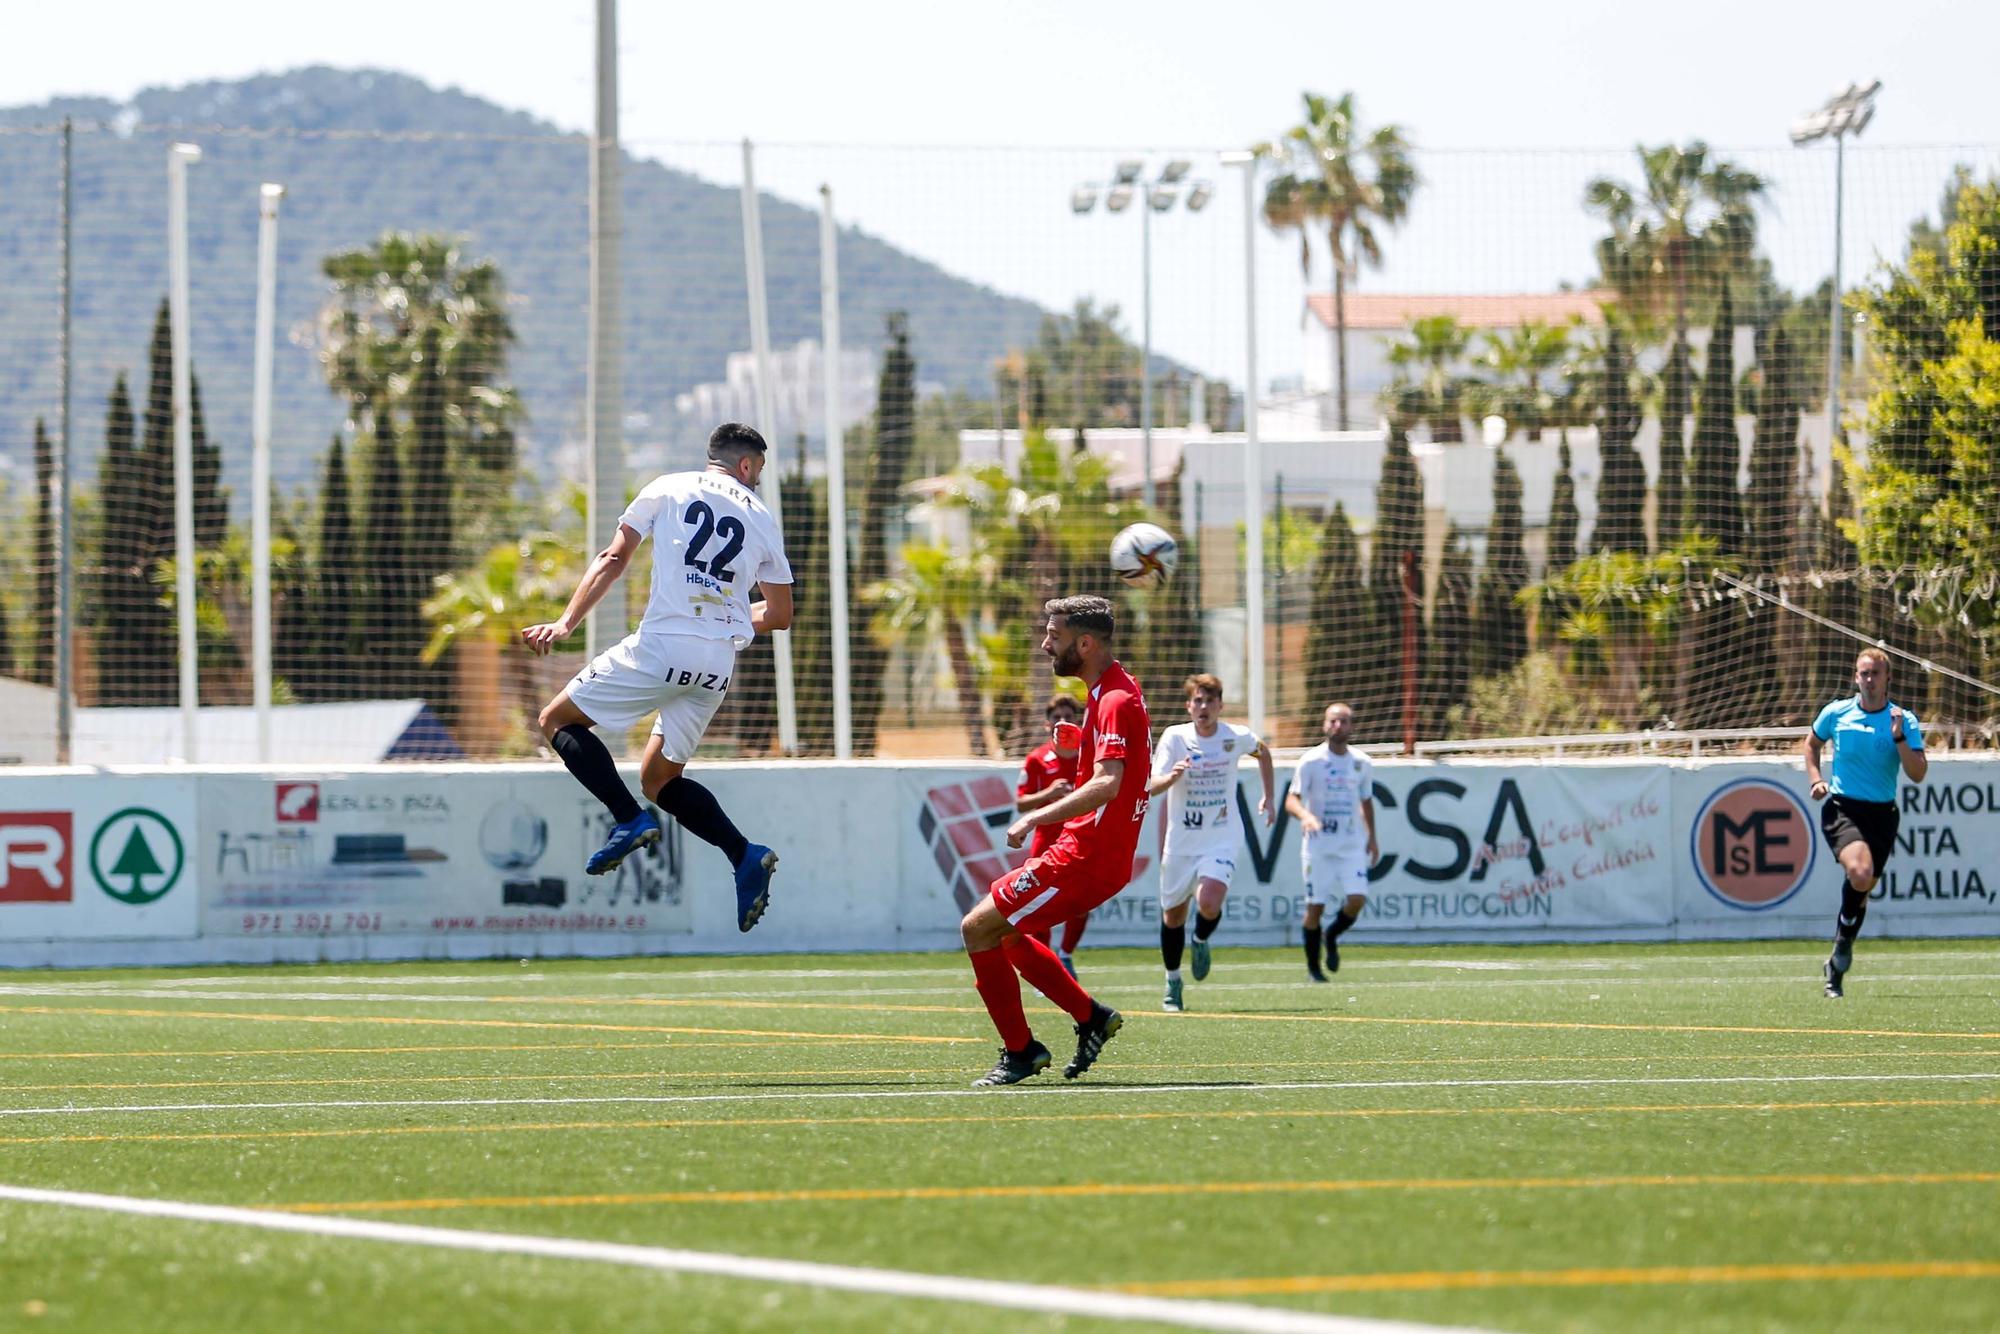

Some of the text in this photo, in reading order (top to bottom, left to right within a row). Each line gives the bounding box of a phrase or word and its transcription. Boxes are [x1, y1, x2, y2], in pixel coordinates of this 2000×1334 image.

[684, 500, 745, 583] 22
[665, 667, 729, 692] IBIZA
[1868, 869, 1996, 905] ULALIA,
[243, 912, 282, 933] 971
